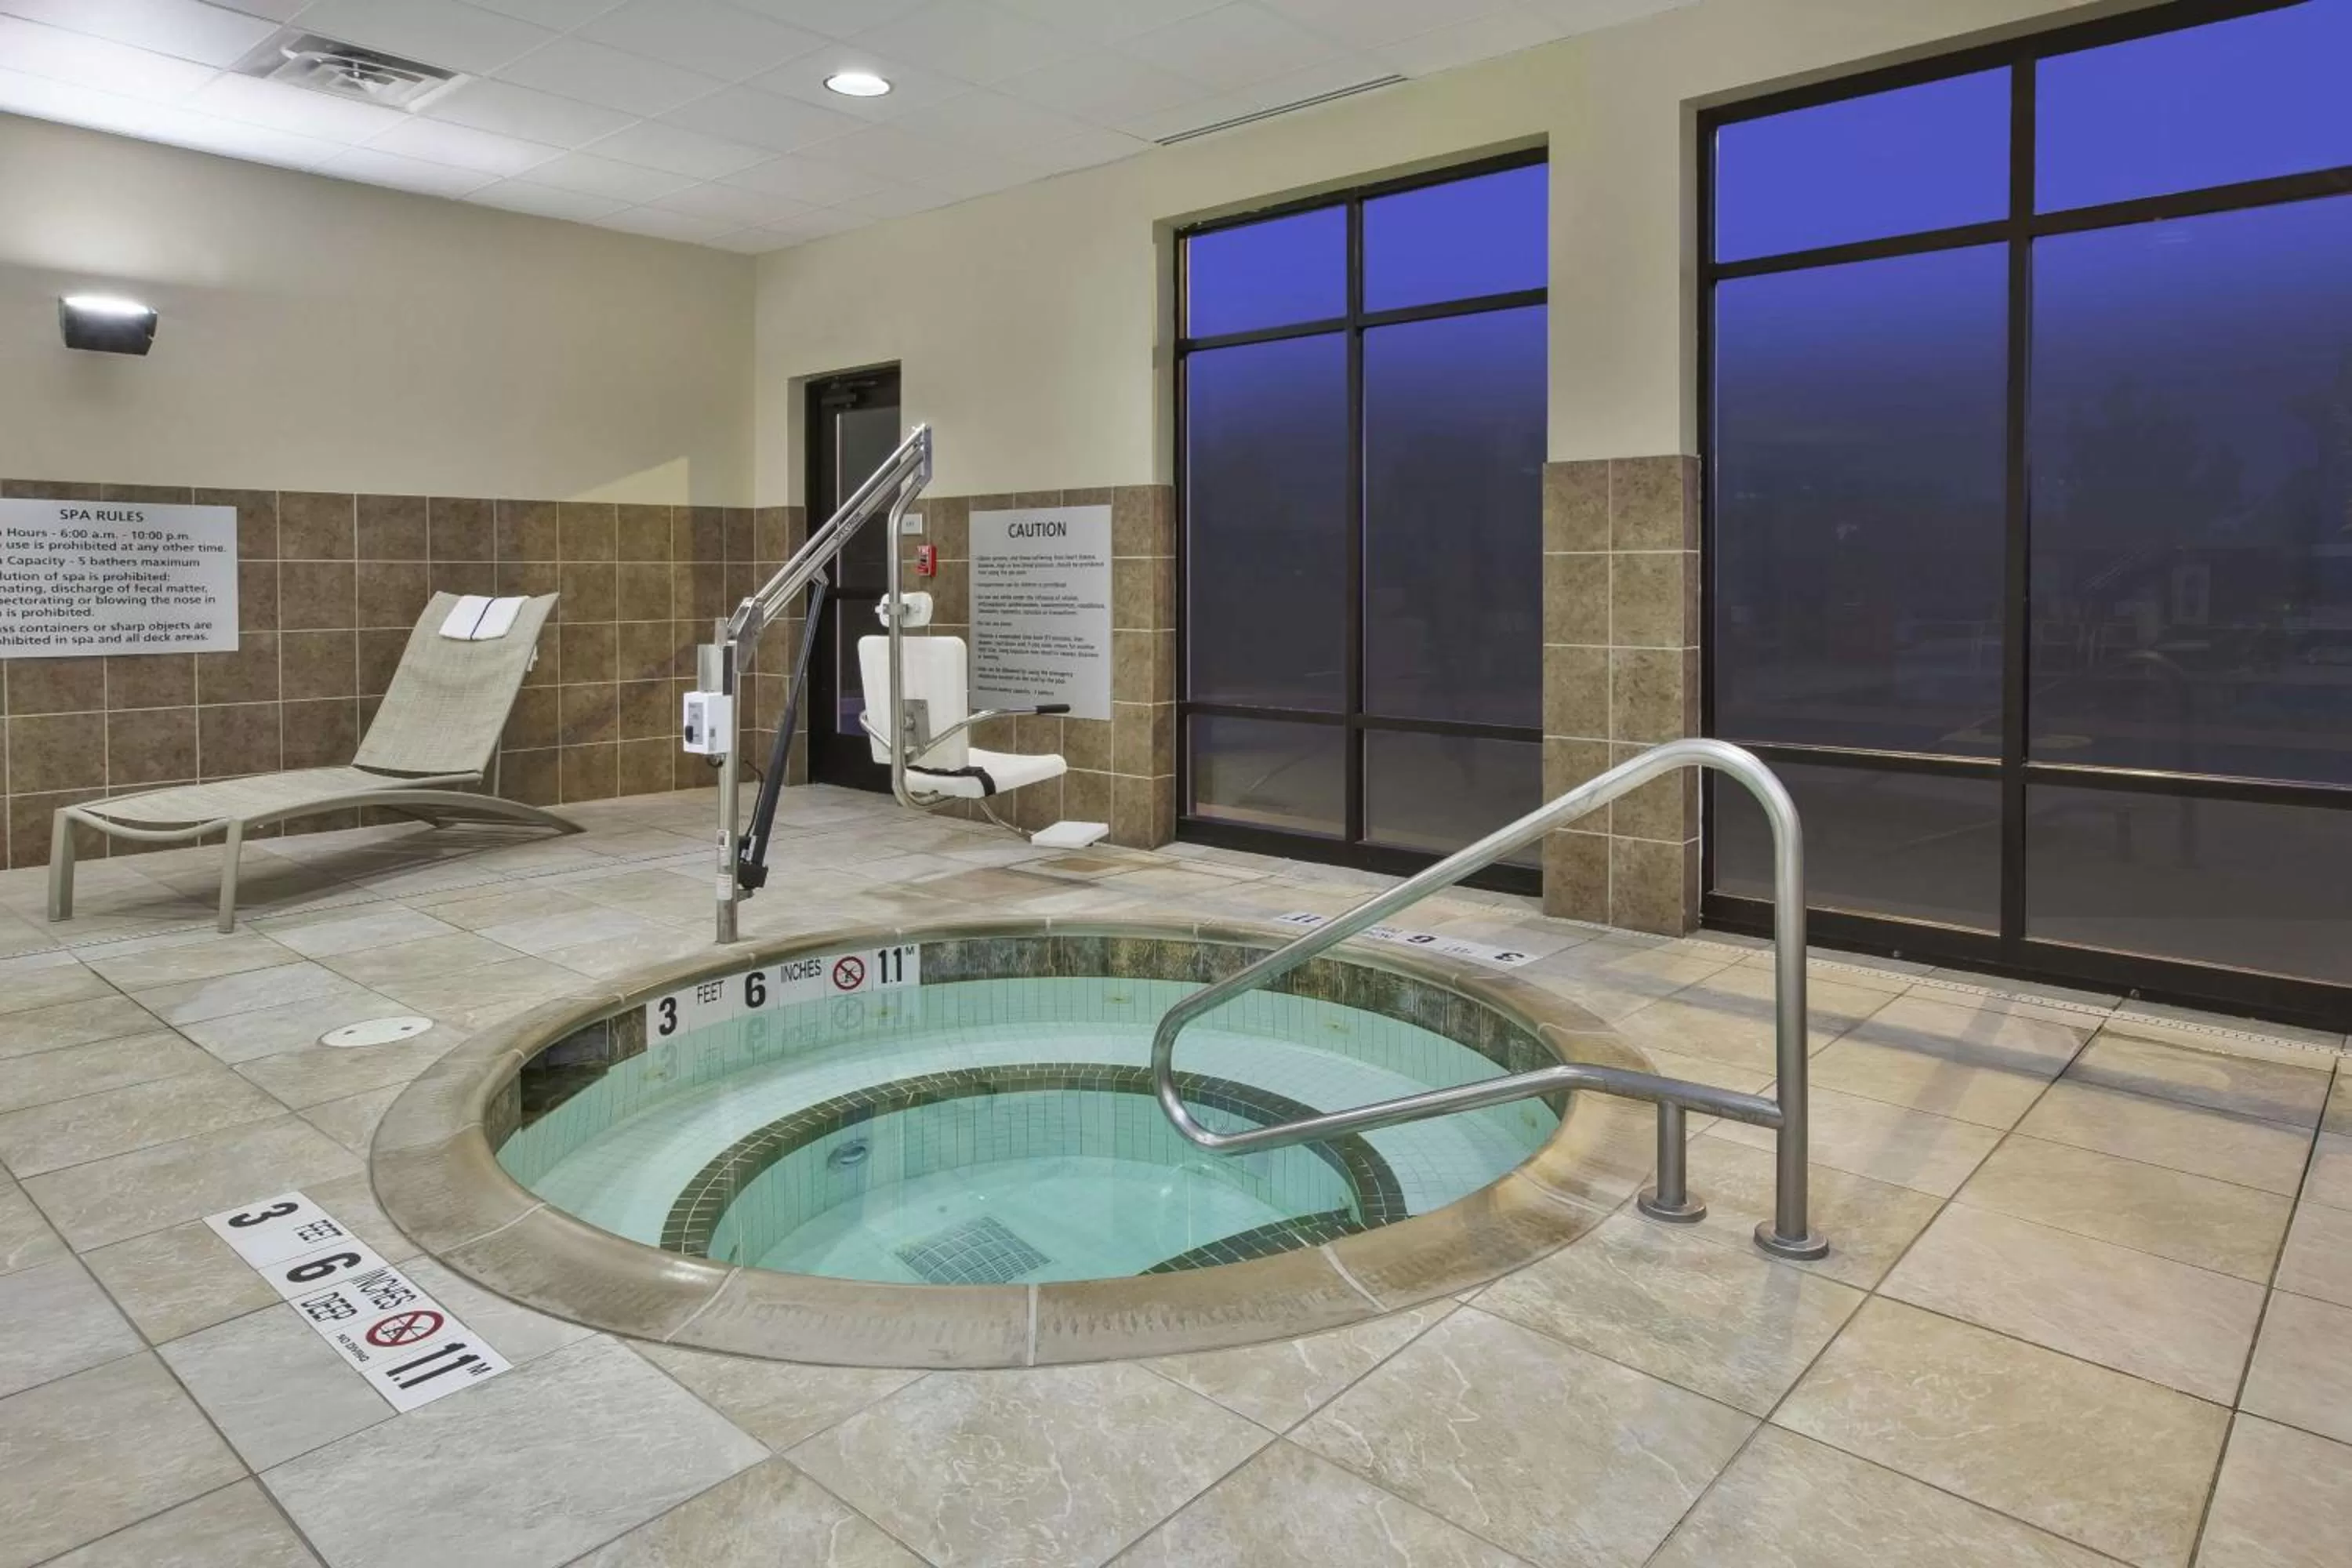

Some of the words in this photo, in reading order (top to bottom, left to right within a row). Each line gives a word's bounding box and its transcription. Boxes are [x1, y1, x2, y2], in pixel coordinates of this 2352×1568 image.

[60, 509, 91, 521] SPA
[96, 510, 144, 522] RULES
[6, 528, 48, 538] Hours
[60, 528, 88, 539] 6:00
[132, 531, 162, 540] 10:00
[1008, 521, 1066, 539] CAUTION
[5, 540, 30, 550] use
[34, 539, 45, 550] is
[49, 540, 117, 551] prohibited
[121, 543, 133, 551] at
[137, 544, 159, 554] any
[162, 543, 194, 552] other
[7, 556, 65, 568] Capacity
[78, 556, 85, 565] 5
[90, 556, 137, 566] bathers
[141, 558, 200, 567] maximum
[44, 572, 57, 581] of
[63, 573, 85, 583] spa
[89, 572, 99, 581] is
[51, 583, 114, 594] discharge
[117, 584, 129, 593] of
[134, 583, 162, 593] fecal
[96, 596, 147, 606] blowing
[151, 596, 170, 604] the
[205, 596, 216, 604] in
[6, 608, 16, 617] is
[20, 623, 89, 633] containers
[111, 622, 145, 632] sharp
[148, 622, 190, 632] objects
[55, 635, 67, 644] in
[71, 636, 93, 646] spa
[98, 633, 122, 644] and
[125, 633, 140, 643] all
[143, 633, 170, 642] deck
[659, 997, 677, 1036] 3
[697, 980, 724, 1004] FEET
[745, 972, 766, 1008] 6
[780, 959, 822, 983] INCHES
[228, 1202, 299, 1228] 3
[293, 1219, 343, 1243] FEET
[286, 1252, 361, 1283] 6
[349, 1269, 417, 1309] INCHES
[300, 1292, 358, 1322] DEEP
[345, 1341, 370, 1362] DIVING
